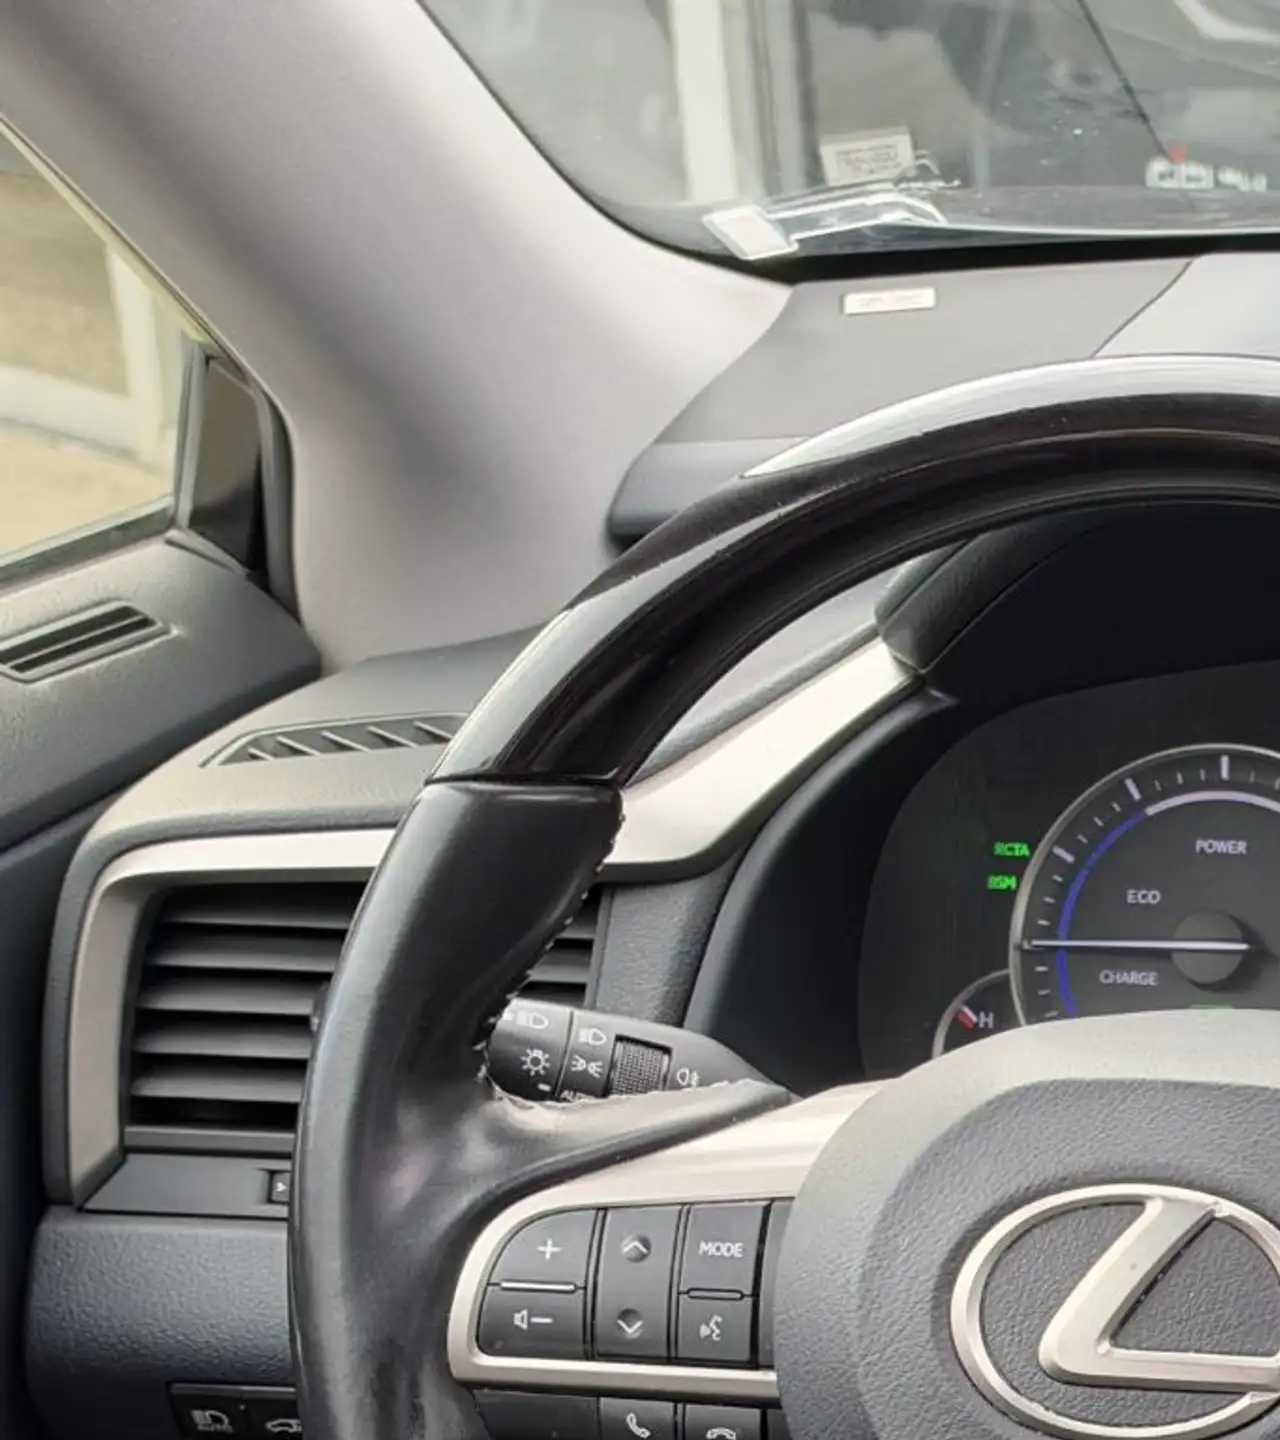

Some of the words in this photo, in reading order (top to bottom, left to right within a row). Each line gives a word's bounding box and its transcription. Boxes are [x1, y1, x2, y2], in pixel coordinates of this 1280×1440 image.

[1195, 838, 1248, 856] POWER
[1127, 889, 1161, 904] ECO
[1099, 969, 1158, 986] CHARGE
[978, 1011, 994, 1029] H
[699, 1241, 744, 1258] MODE
